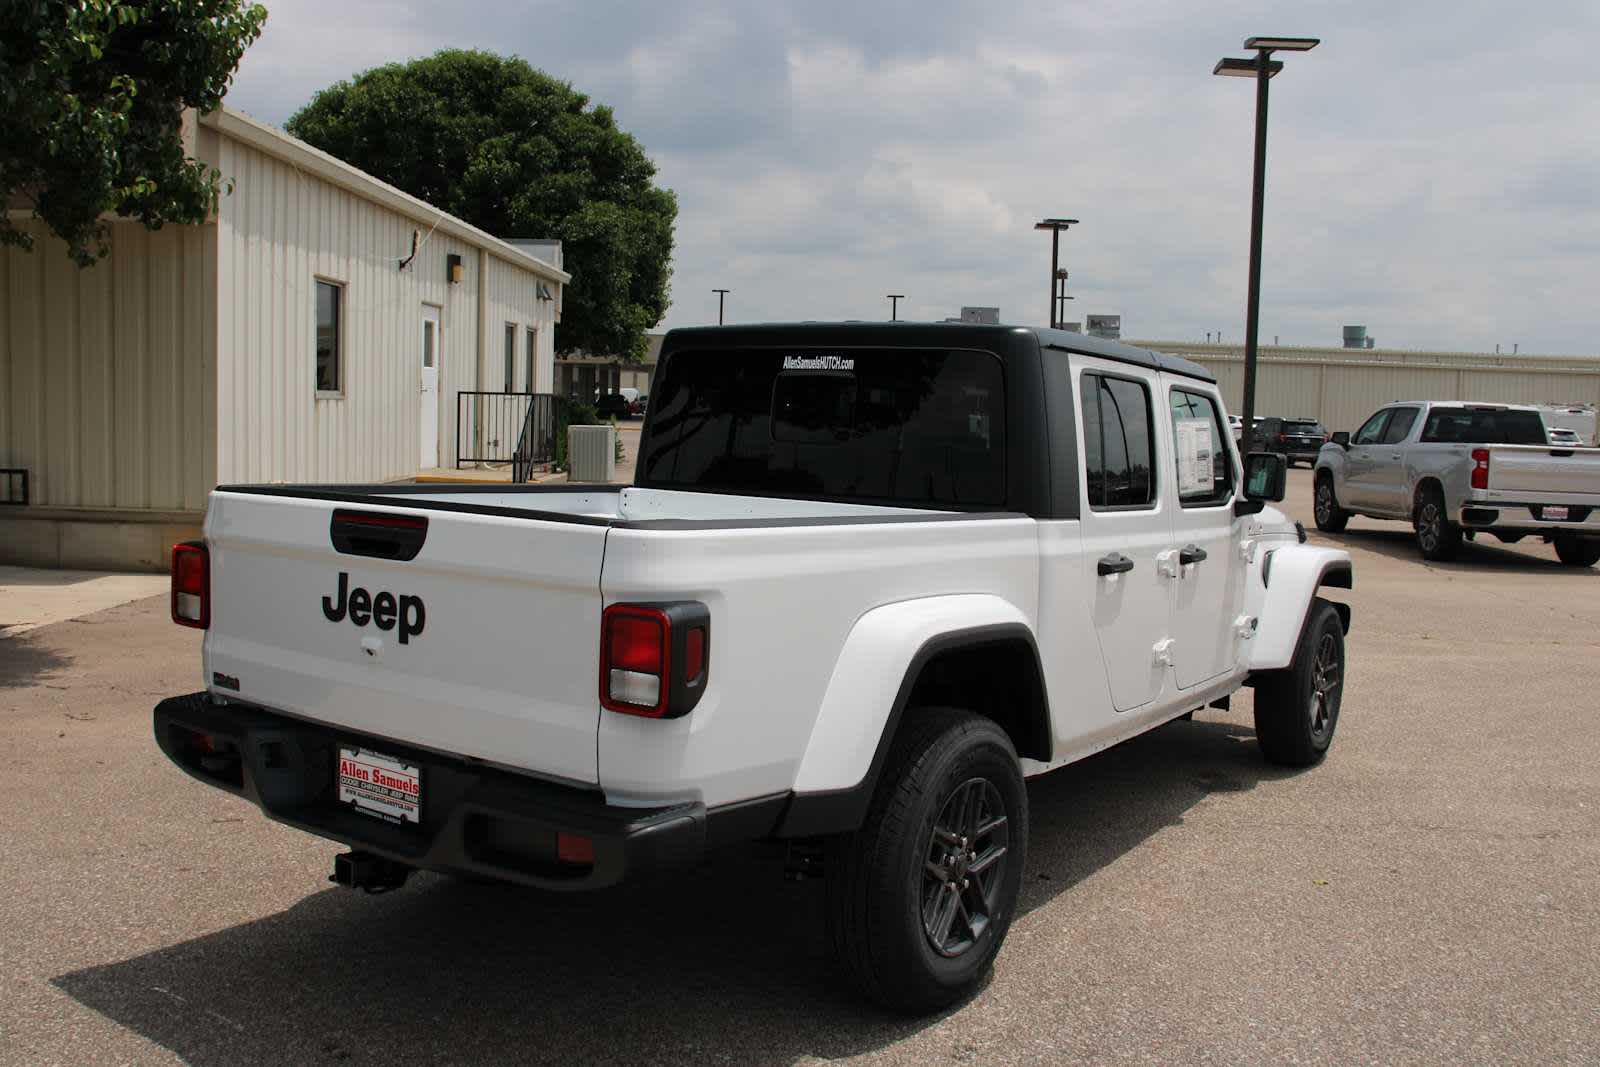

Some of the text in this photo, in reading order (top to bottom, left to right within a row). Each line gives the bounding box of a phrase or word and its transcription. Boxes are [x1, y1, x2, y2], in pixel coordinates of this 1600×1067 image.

[783, 355, 855, 370] AllenSamuelsHUTCH.com
[322, 572, 426, 645] Jeep
[340, 760, 419, 795] Allen Samuels
[361, 782, 389, 796] CHRYSLER
